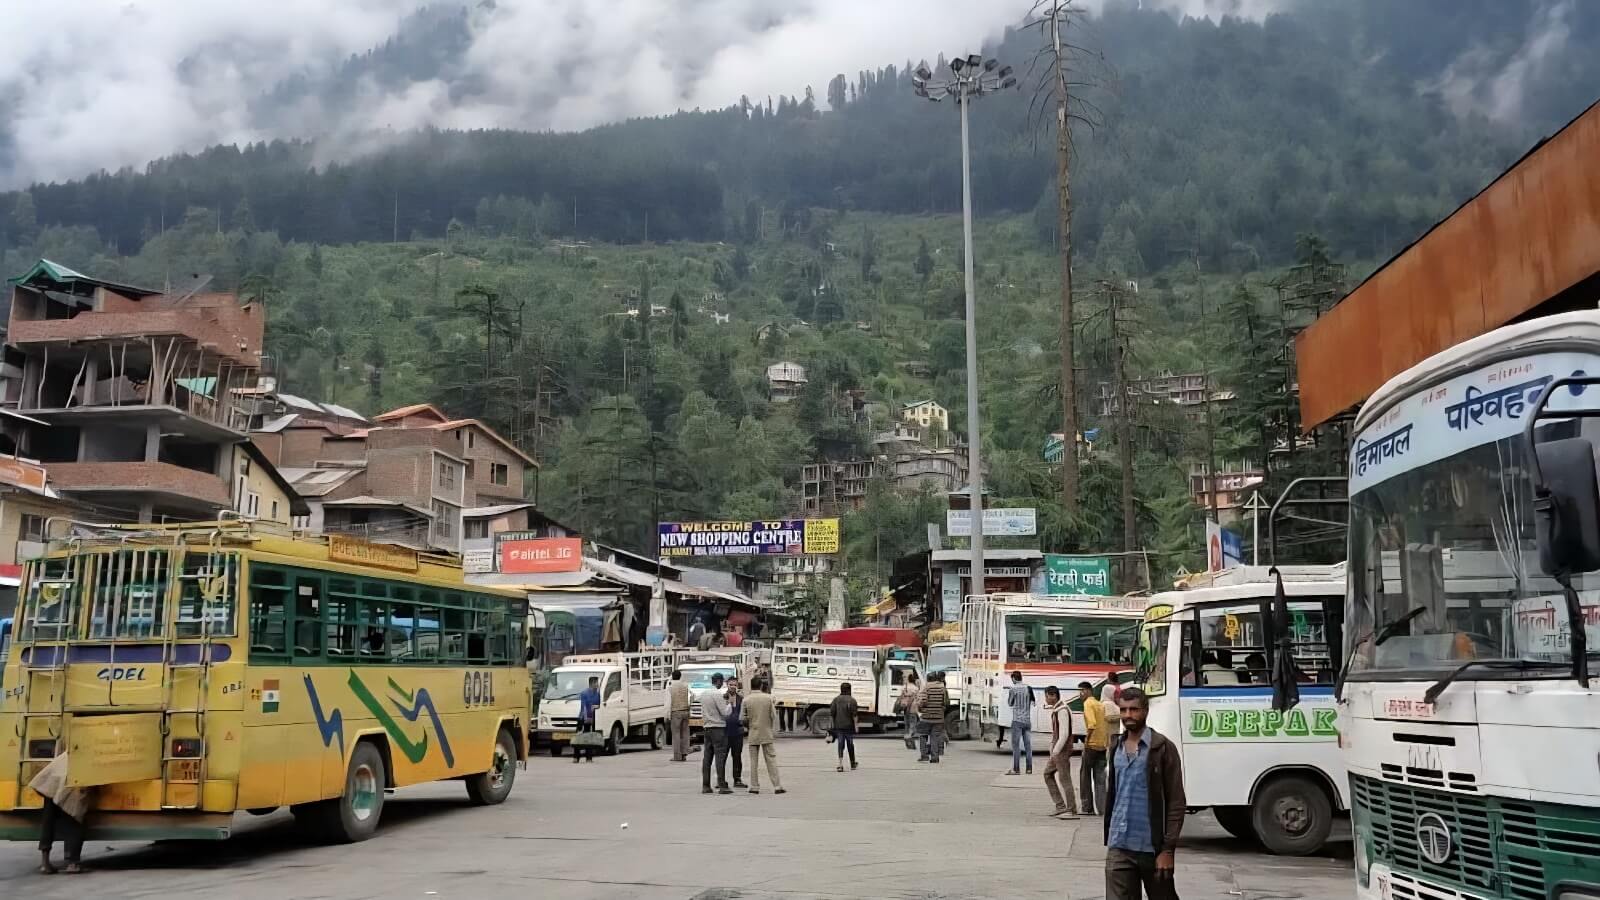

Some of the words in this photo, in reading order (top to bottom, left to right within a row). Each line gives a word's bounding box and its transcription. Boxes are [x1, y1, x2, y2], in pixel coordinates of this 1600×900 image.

[1355, 423, 1414, 477] हिमाचल
[679, 521, 752, 533] WELCOME
[762, 521, 782, 530] TO
[660, 532, 689, 547] NEW
[690, 531, 750, 546] SHOPPING
[753, 530, 802, 545] CENTRE
[520, 548, 550, 560] airtel
[1189, 708, 1339, 737] DEEPAK
